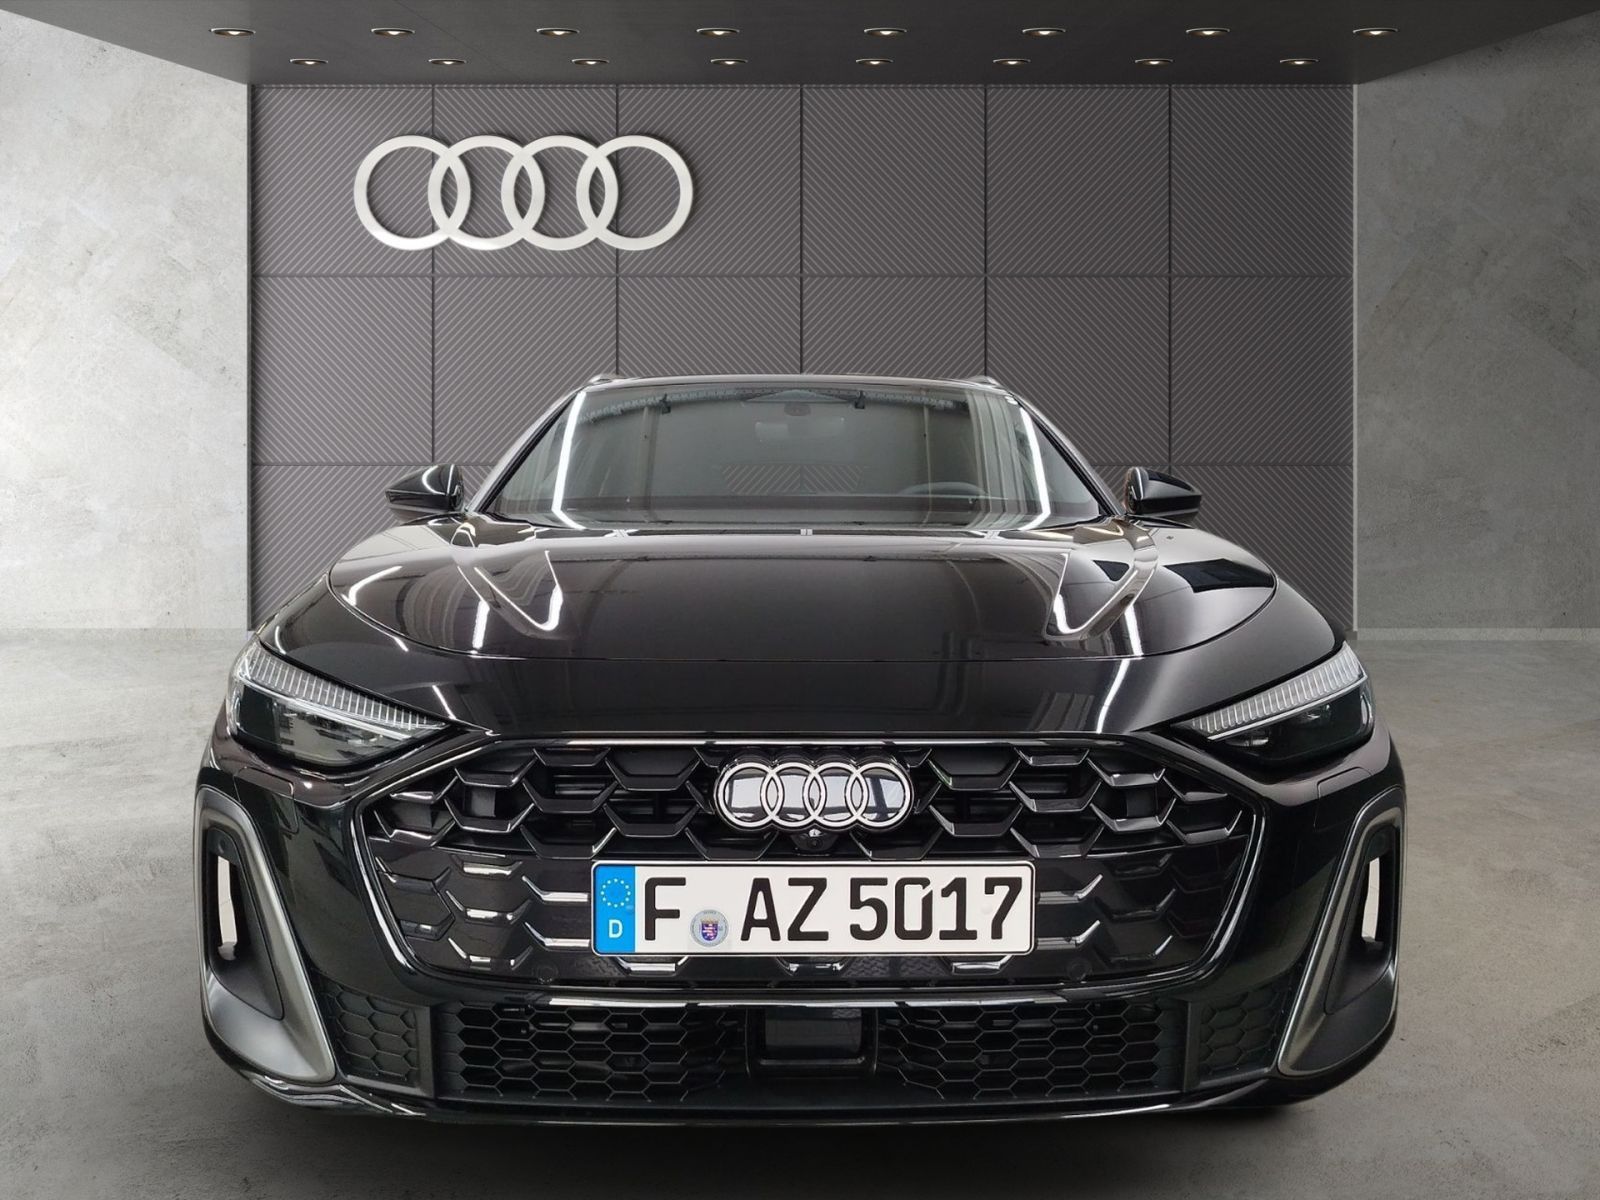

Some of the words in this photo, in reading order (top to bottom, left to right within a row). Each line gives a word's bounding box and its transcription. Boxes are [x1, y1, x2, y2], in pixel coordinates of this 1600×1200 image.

[608, 919, 623, 939] D
[644, 877, 687, 941] F
[740, 877, 829, 941] AZ
[849, 876, 1023, 941] 5017
